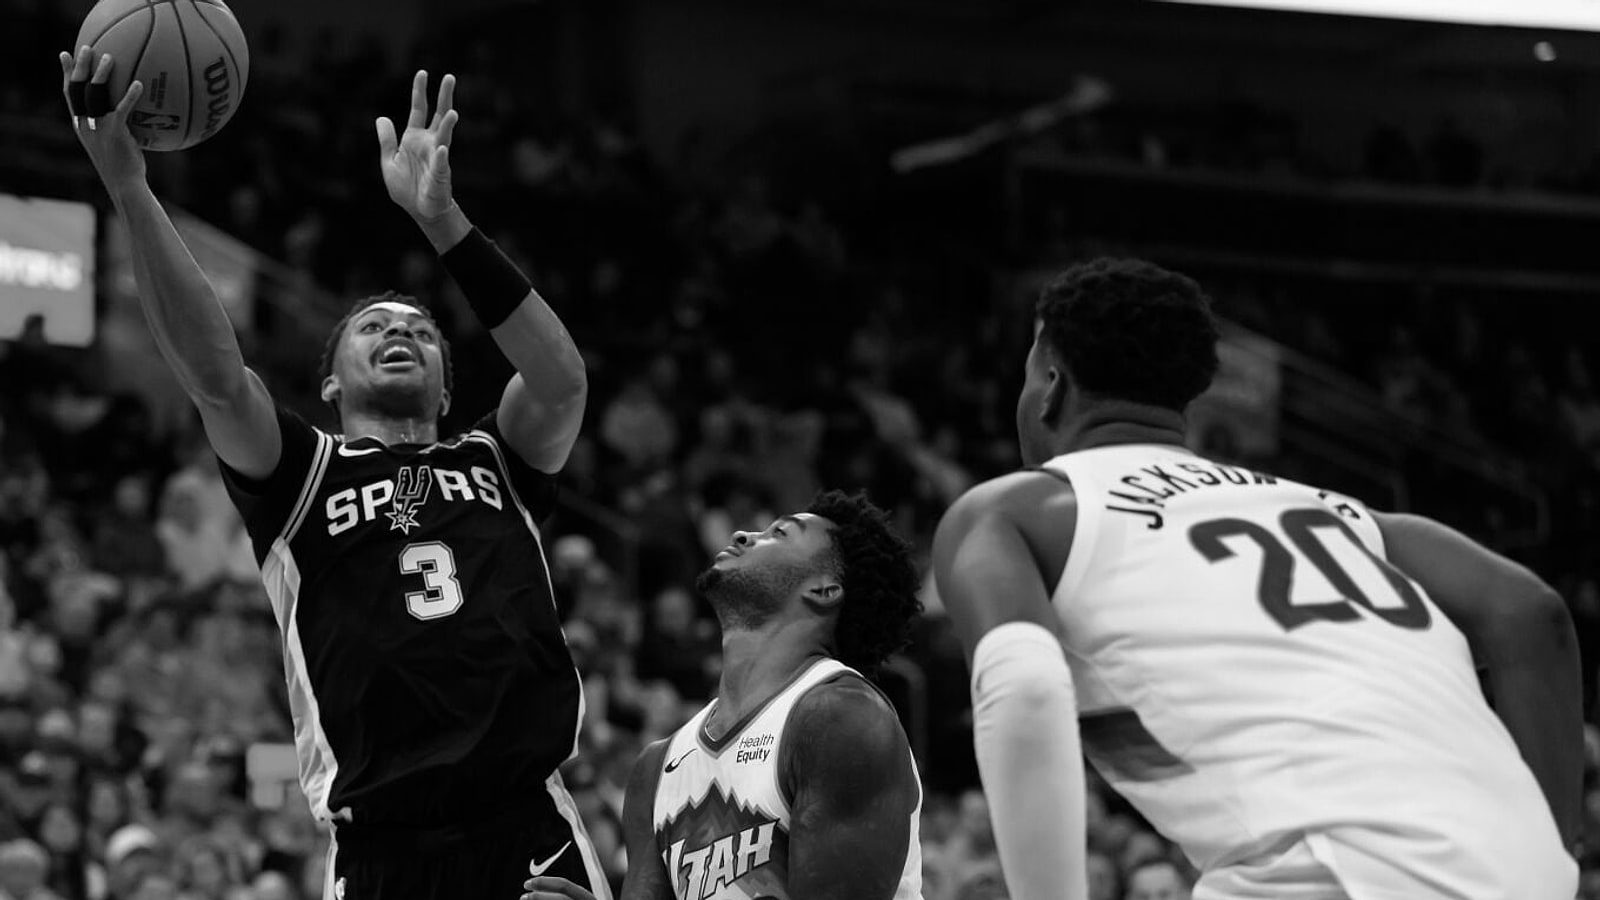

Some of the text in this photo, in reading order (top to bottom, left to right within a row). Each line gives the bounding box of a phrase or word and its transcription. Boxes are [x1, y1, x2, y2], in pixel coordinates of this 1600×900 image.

[325, 464, 503, 536] SPURS
[398, 539, 464, 621] 3
[1187, 507, 1432, 633] 20
[736, 747, 771, 765] Equity
[738, 732, 775, 749] Health
